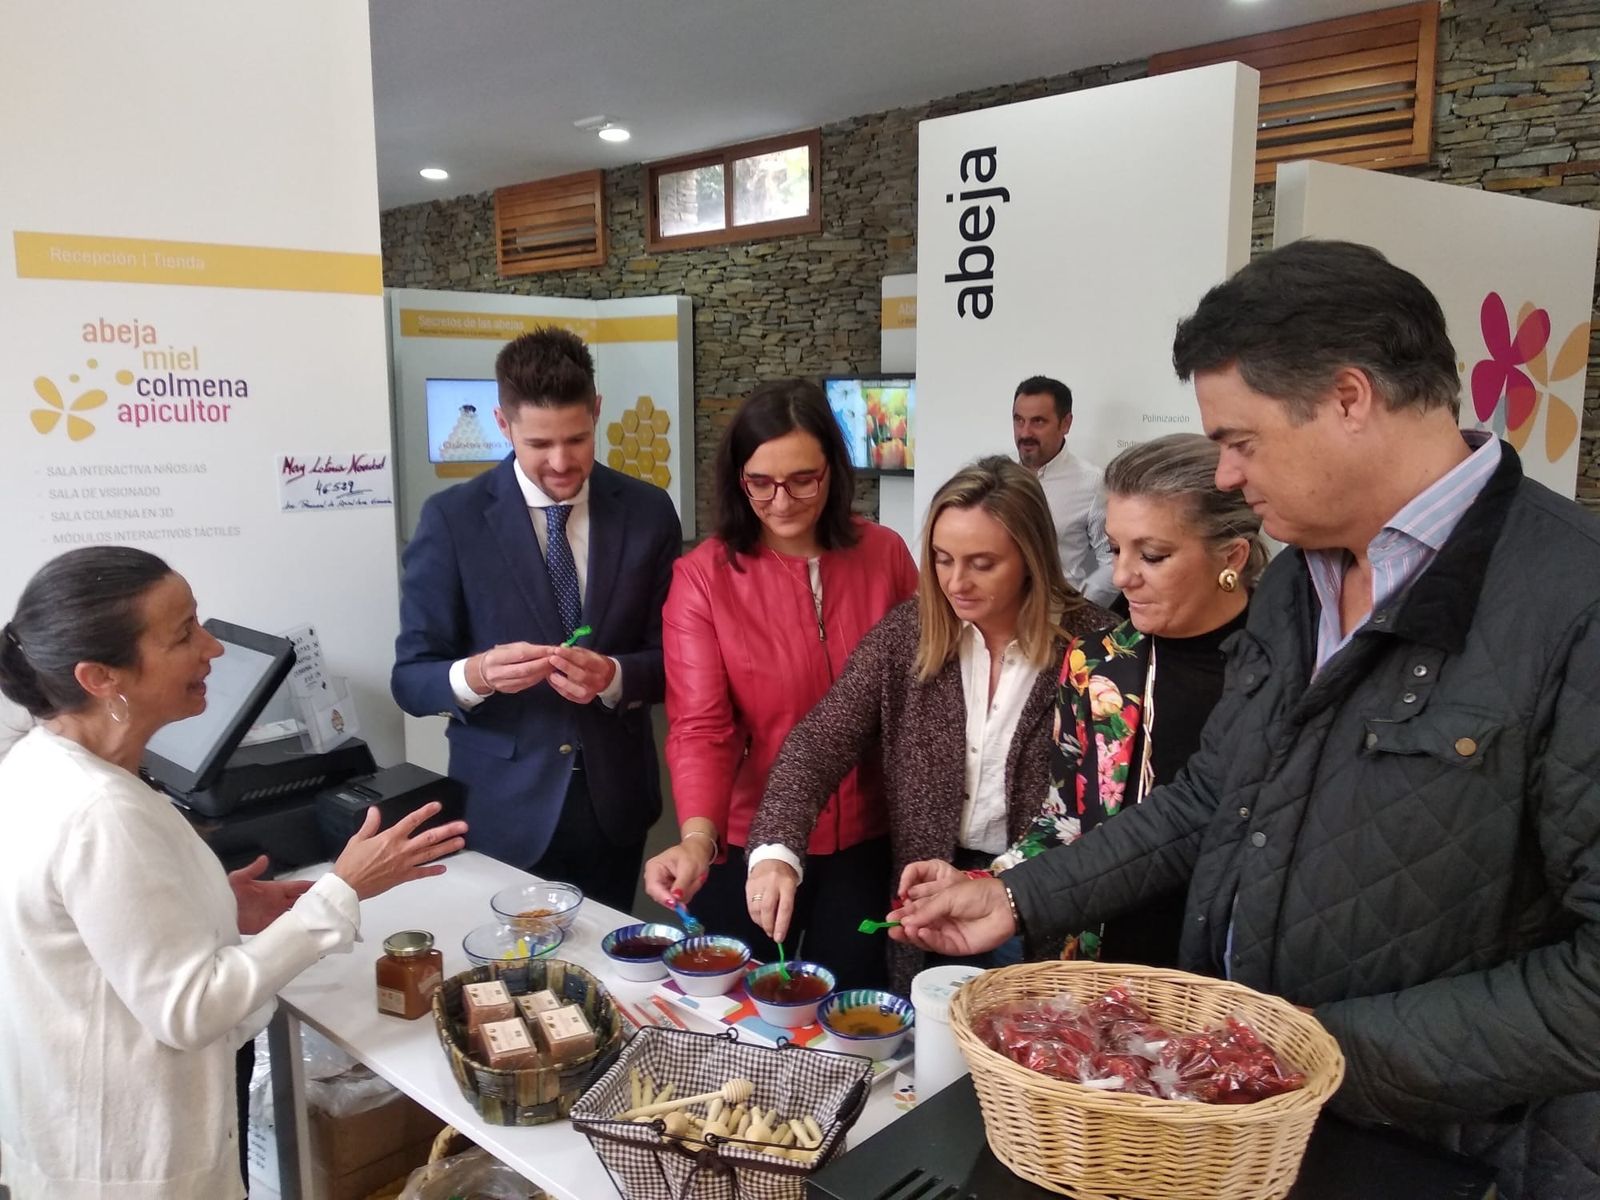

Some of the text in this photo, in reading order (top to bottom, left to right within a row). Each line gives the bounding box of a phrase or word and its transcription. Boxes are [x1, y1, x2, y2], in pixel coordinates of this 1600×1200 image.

[945, 146, 1010, 320] abeja
[49, 247, 205, 271] Recepción Tienda
[82, 317, 157, 348] abeja
[143, 346, 199, 370] miel
[137, 373, 248, 397] colmena
[118, 398, 231, 427] apicultor
[46, 466, 78, 477] SALA
[79, 464, 152, 476] INTERACTIVA
[48, 486, 161, 499] SALA DE VISIONADO
[51, 510, 82, 522] SALA
[83, 509, 140, 521] COLMENA
[142, 507, 157, 519] EN
[53, 531, 113, 544] MÓDULOS
[113, 529, 193, 542] INTERACTIVOS
